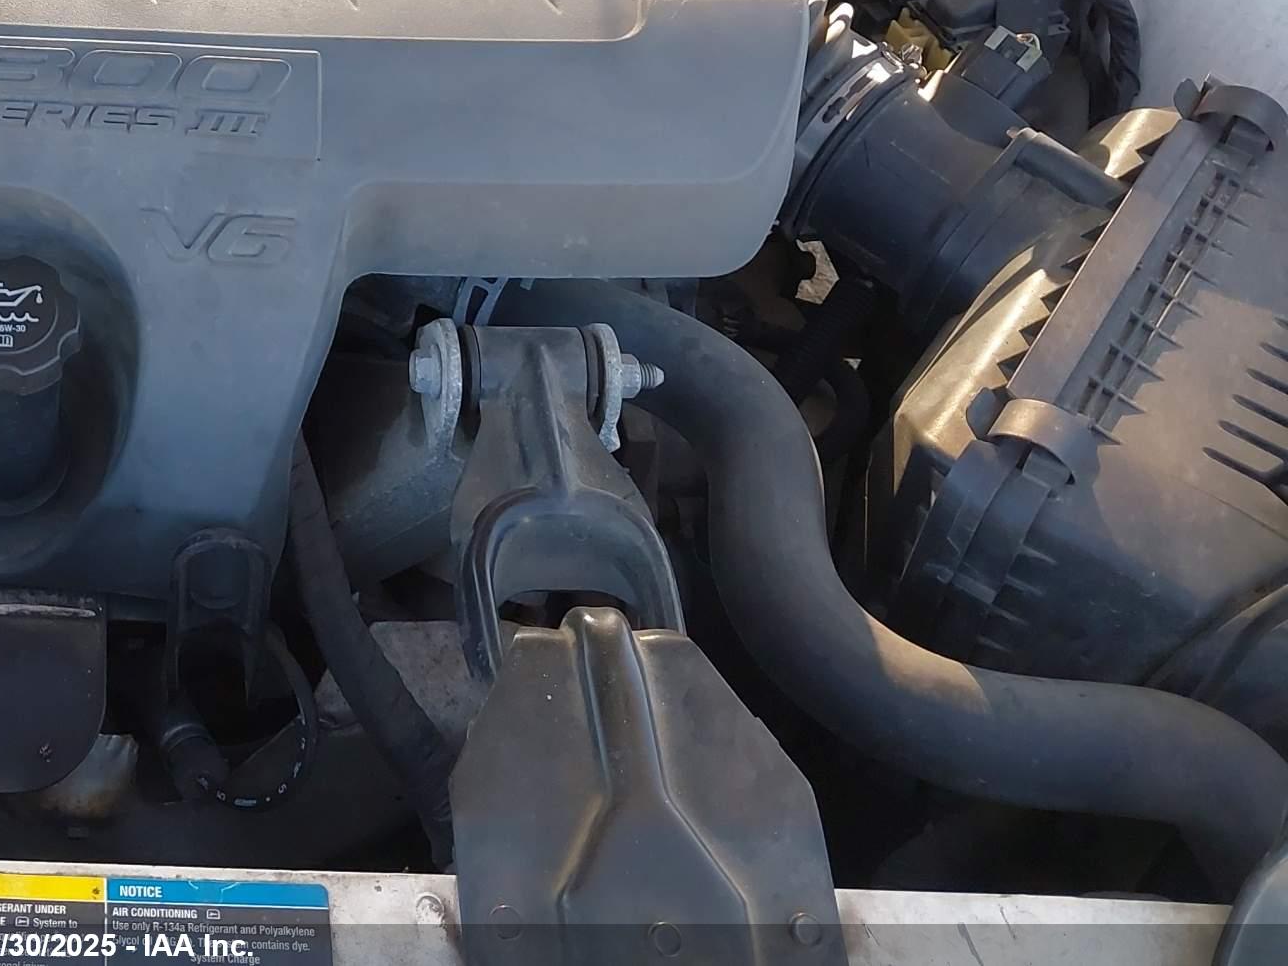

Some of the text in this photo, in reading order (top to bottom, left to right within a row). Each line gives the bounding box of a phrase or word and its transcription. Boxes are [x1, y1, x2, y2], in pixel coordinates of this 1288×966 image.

[140, 206, 298, 264] V6
[0, 324, 26, 332] 5W-30
[119, 886, 162, 898] NOTICE
[35, 903, 66, 914] UNDER
[113, 907, 197, 918] AIR CONDITIONING
[33, 918, 66, 929] System
[68, 918, 78, 928] to
[113, 920, 315, 938] Use only R-134a Refrigerant and Polyalkylene
[252, 940, 290, 951] contains
[292, 941, 311, 953] dye.
